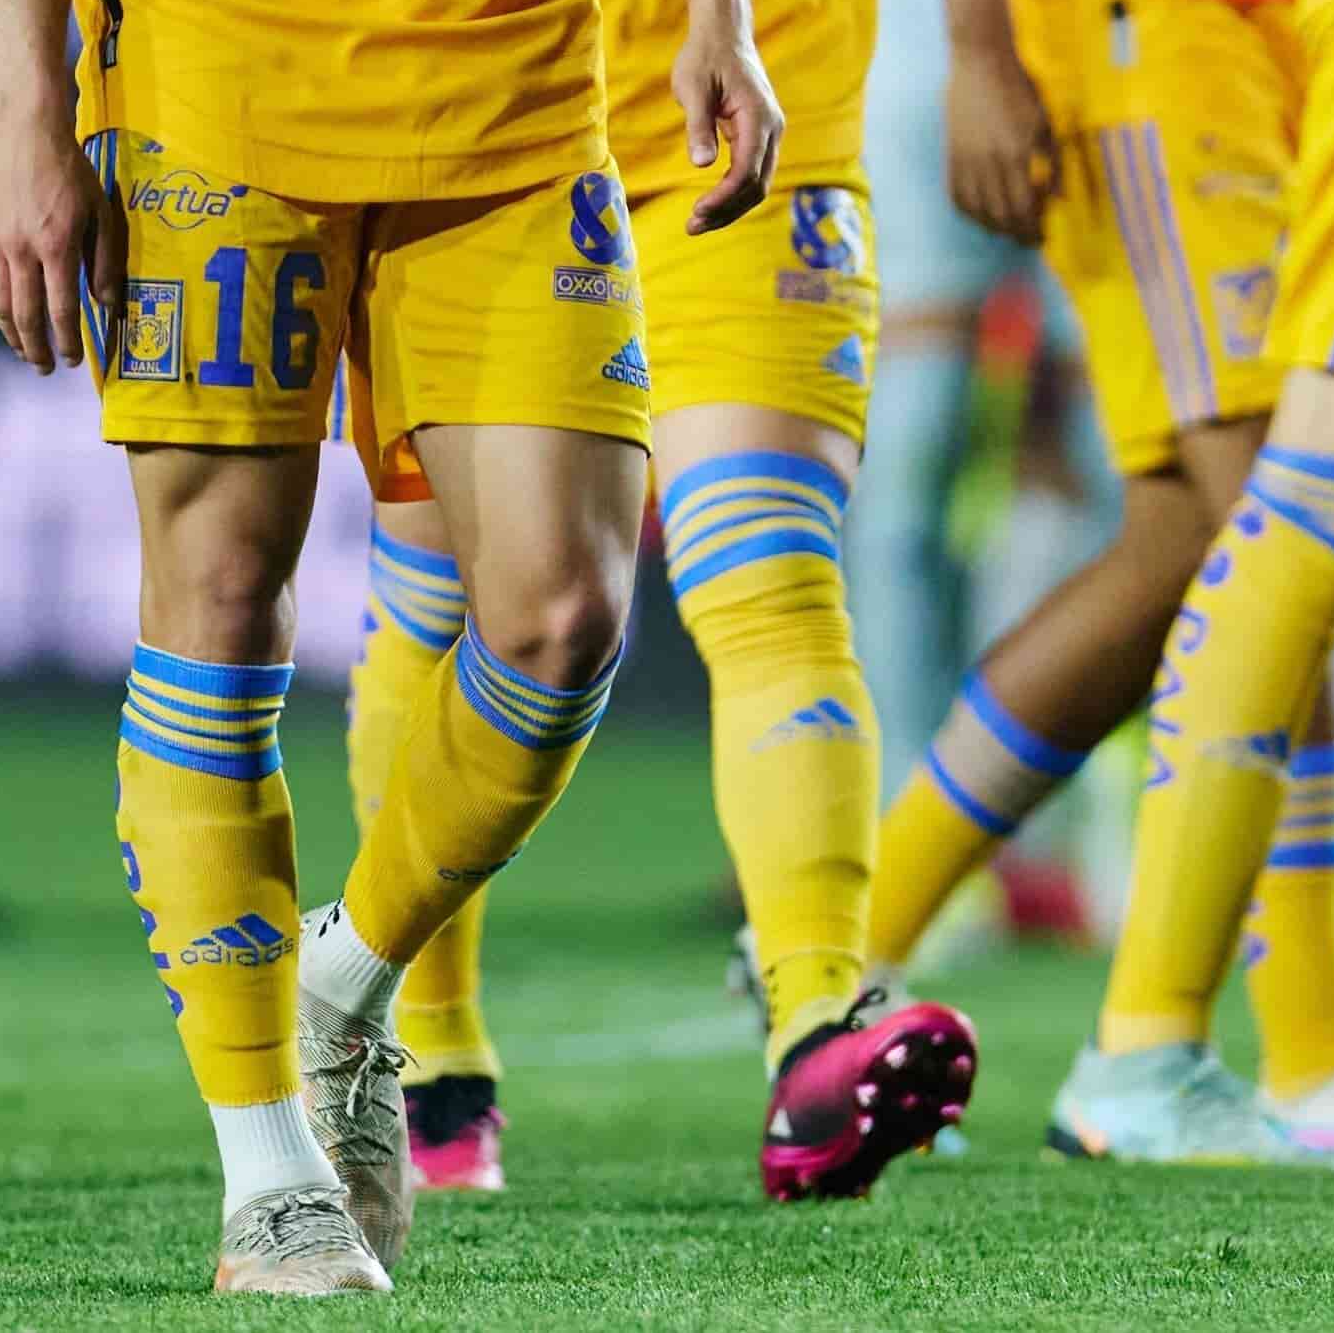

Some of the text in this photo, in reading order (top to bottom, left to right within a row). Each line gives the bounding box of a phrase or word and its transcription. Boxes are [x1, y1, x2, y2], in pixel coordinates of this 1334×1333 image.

[128, 178, 231, 216] Vertua
[558, 275, 606, 296] OXXO
[198, 246, 327, 390] 16
[130, 360, 162, 373] UANL
[180, 937, 295, 967] adidas
